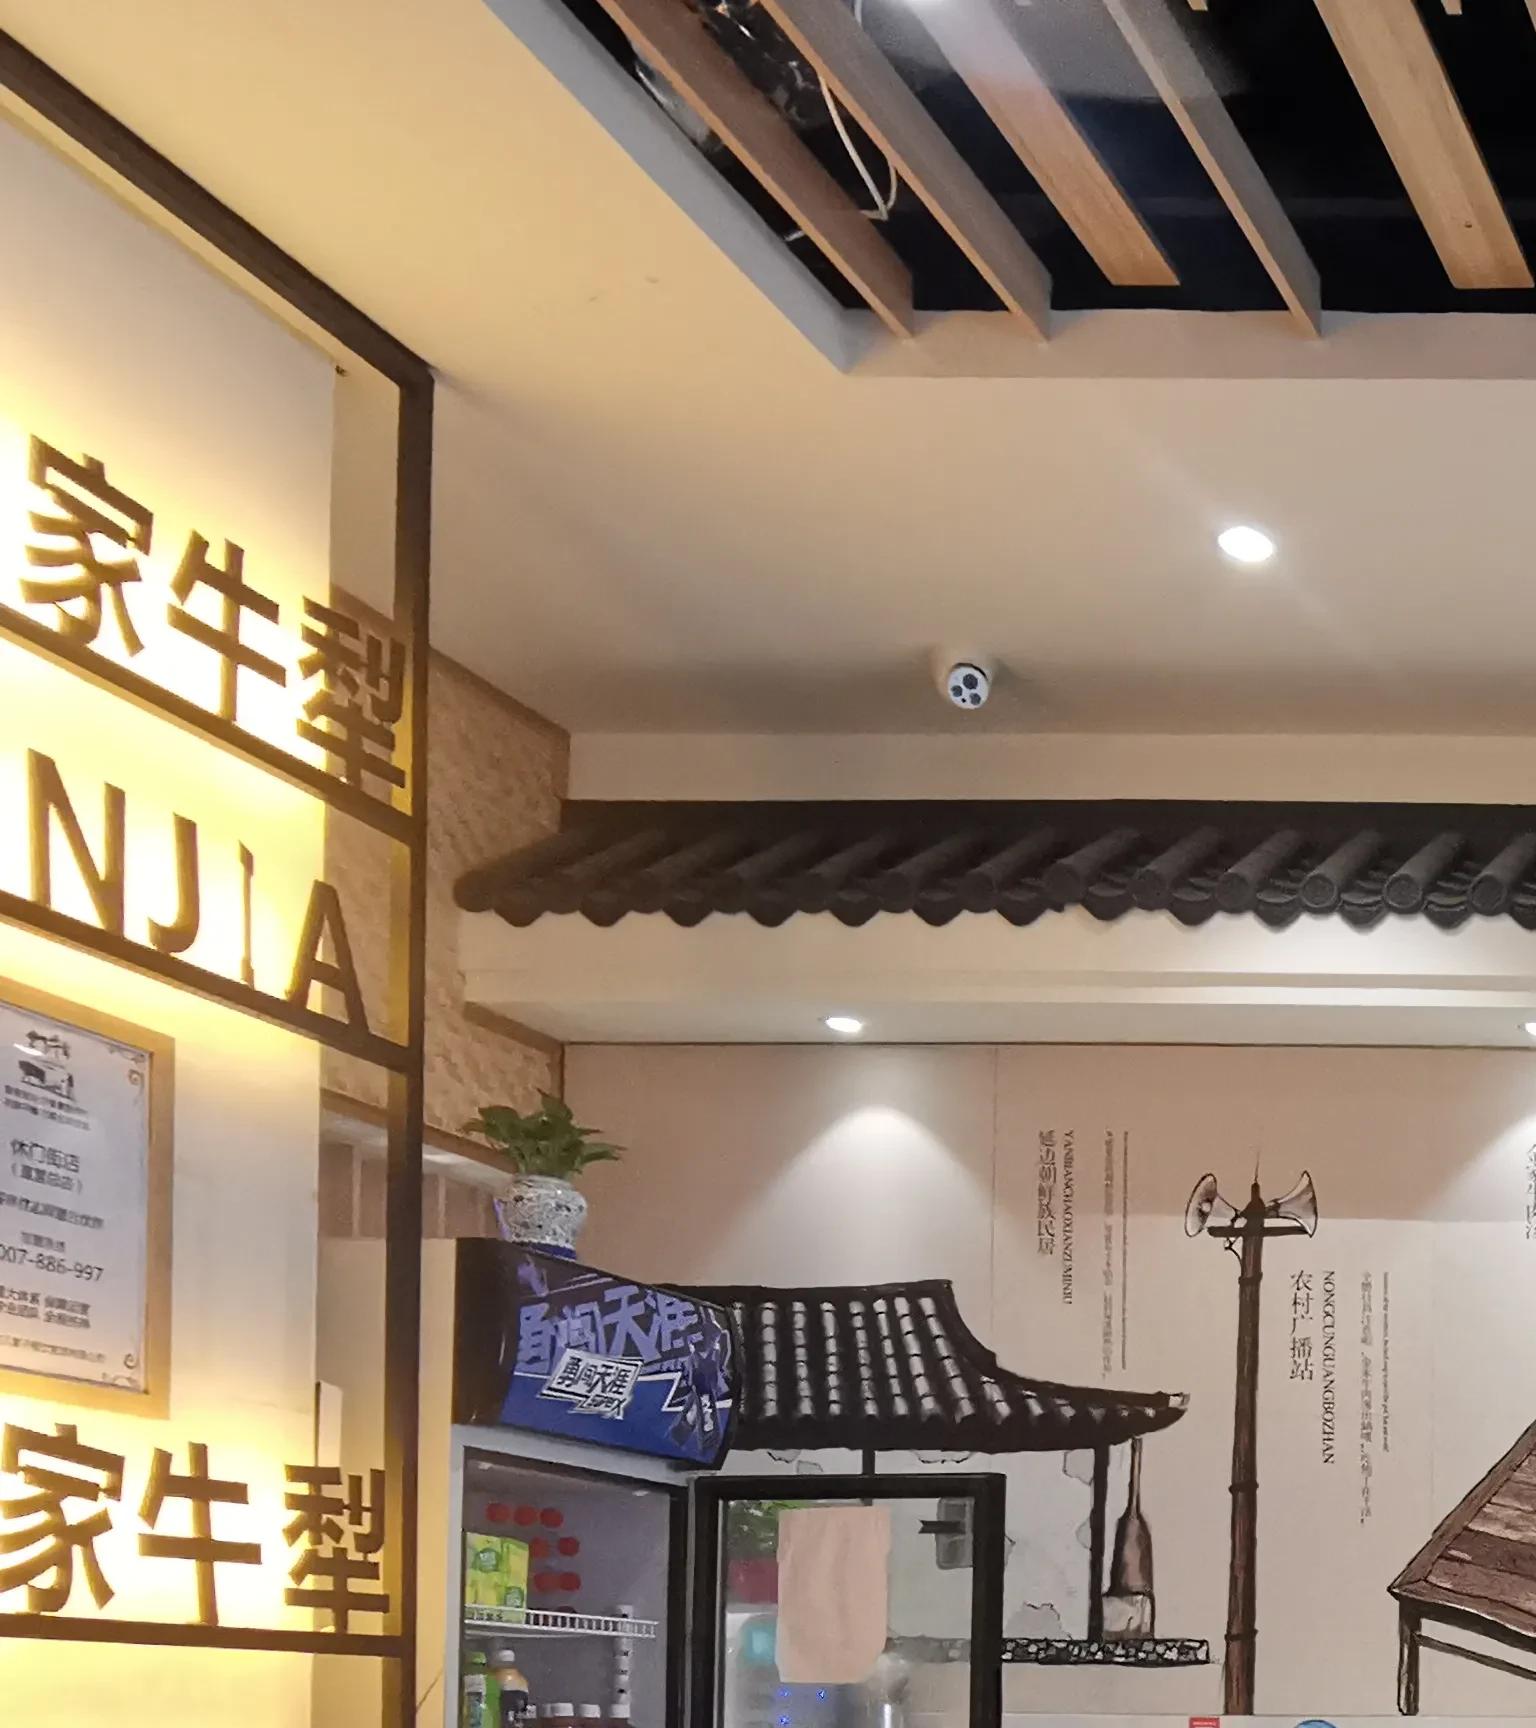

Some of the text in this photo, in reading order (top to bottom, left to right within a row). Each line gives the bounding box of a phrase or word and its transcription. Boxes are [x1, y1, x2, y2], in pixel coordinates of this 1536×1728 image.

[18, 433, 406, 790] 家牛犁
[1289, 1269, 1314, 1382] 农村广播站
[1321, 1269, 1336, 1465] NONGCUNGUANGBOZHAN
[0, 1422, 390, 1634] 家牛犁
